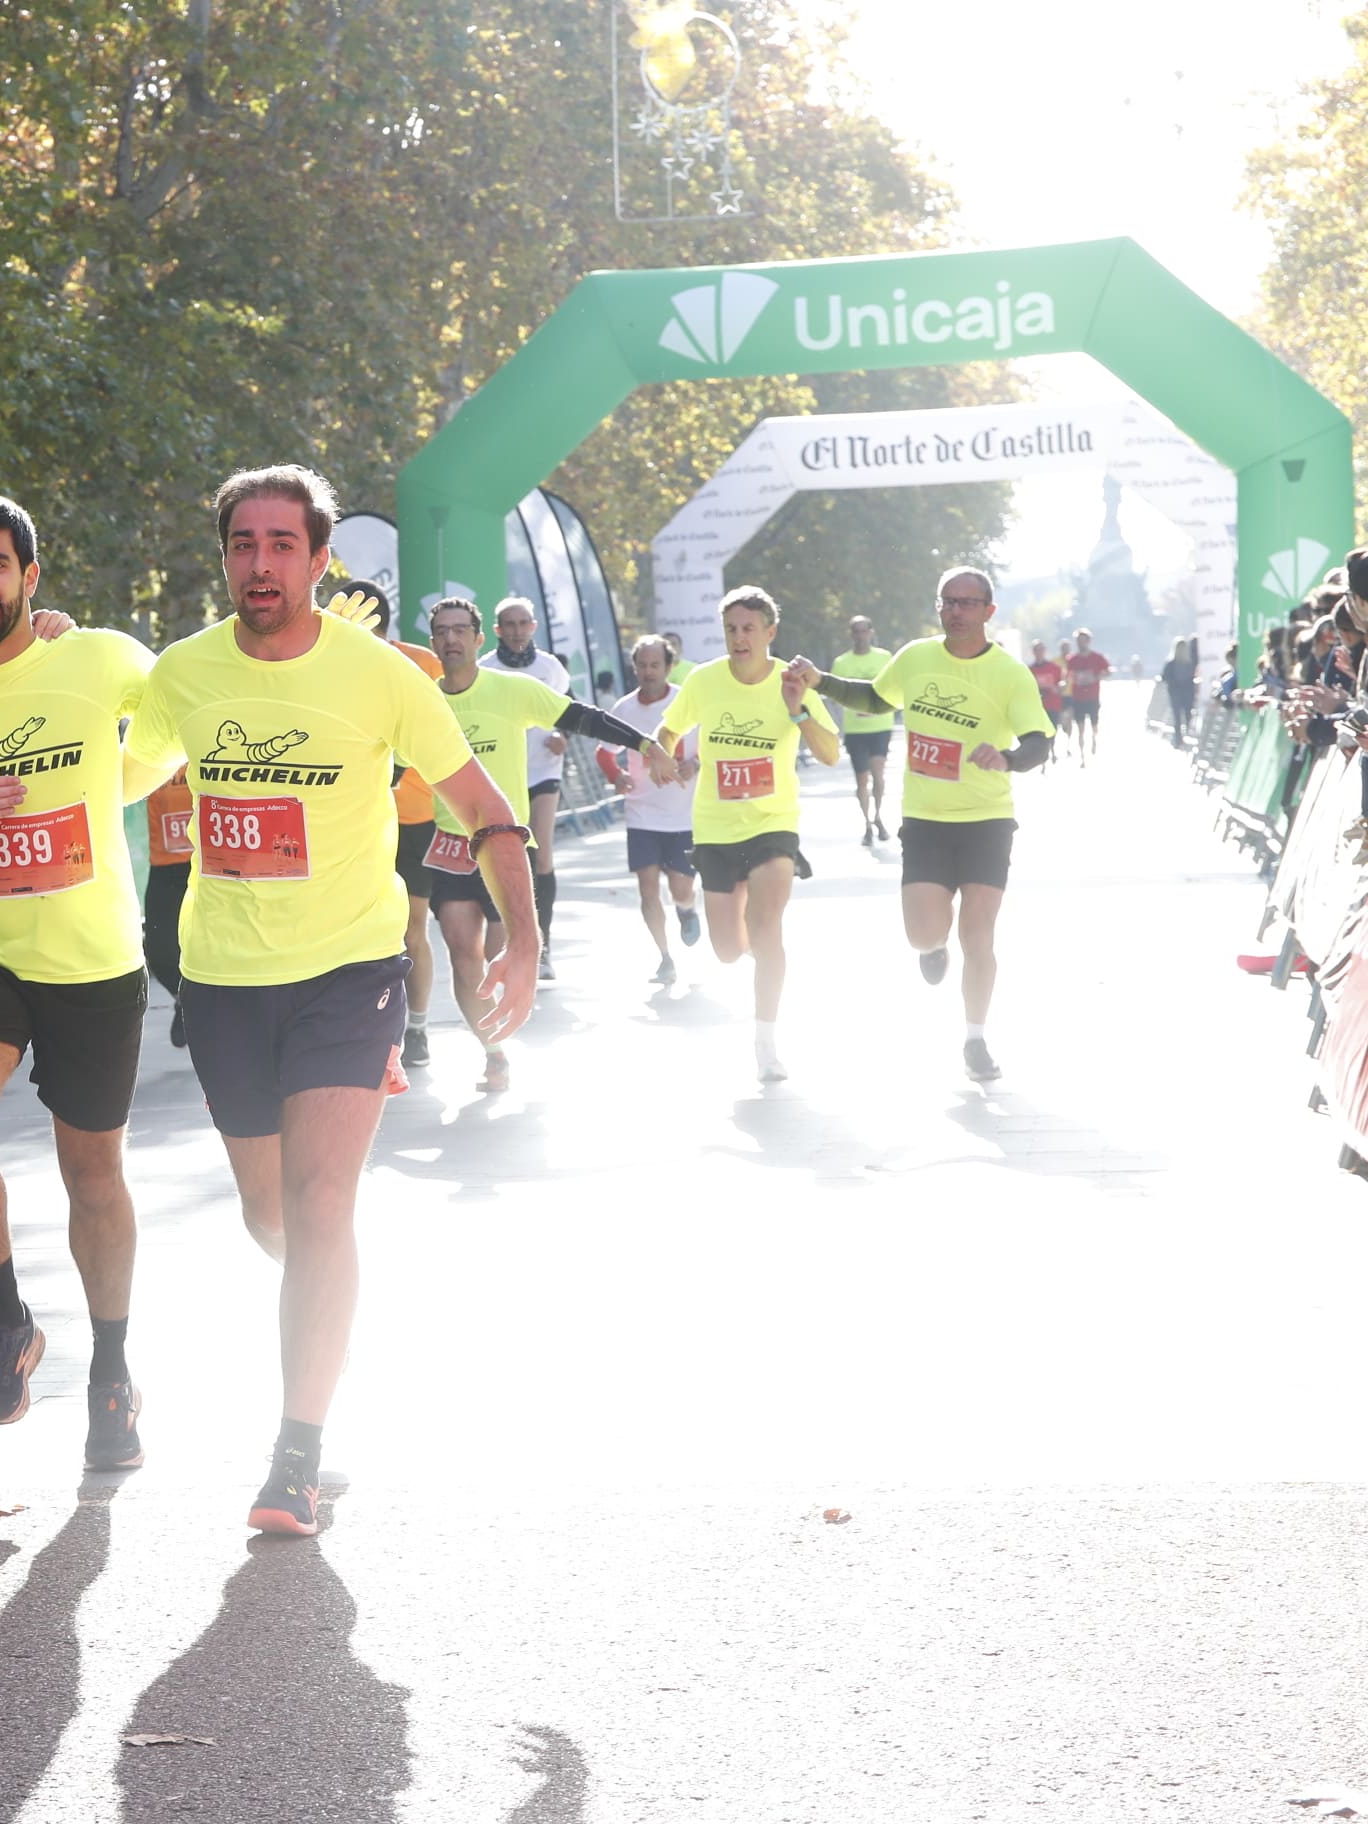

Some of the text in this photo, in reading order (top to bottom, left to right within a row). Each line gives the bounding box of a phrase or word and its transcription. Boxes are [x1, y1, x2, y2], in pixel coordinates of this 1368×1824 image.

[794, 280, 1055, 350] Unicaja
[800, 422, 1094, 471] El Norte de Castilla
[910, 703, 979, 728] MICHELIN
[708, 735, 776, 750] MICHELIN
[912, 740, 940, 764] 272
[199, 767, 340, 786] MICHELIN
[723, 767, 751, 786] 271
[209, 812, 261, 850] 338
